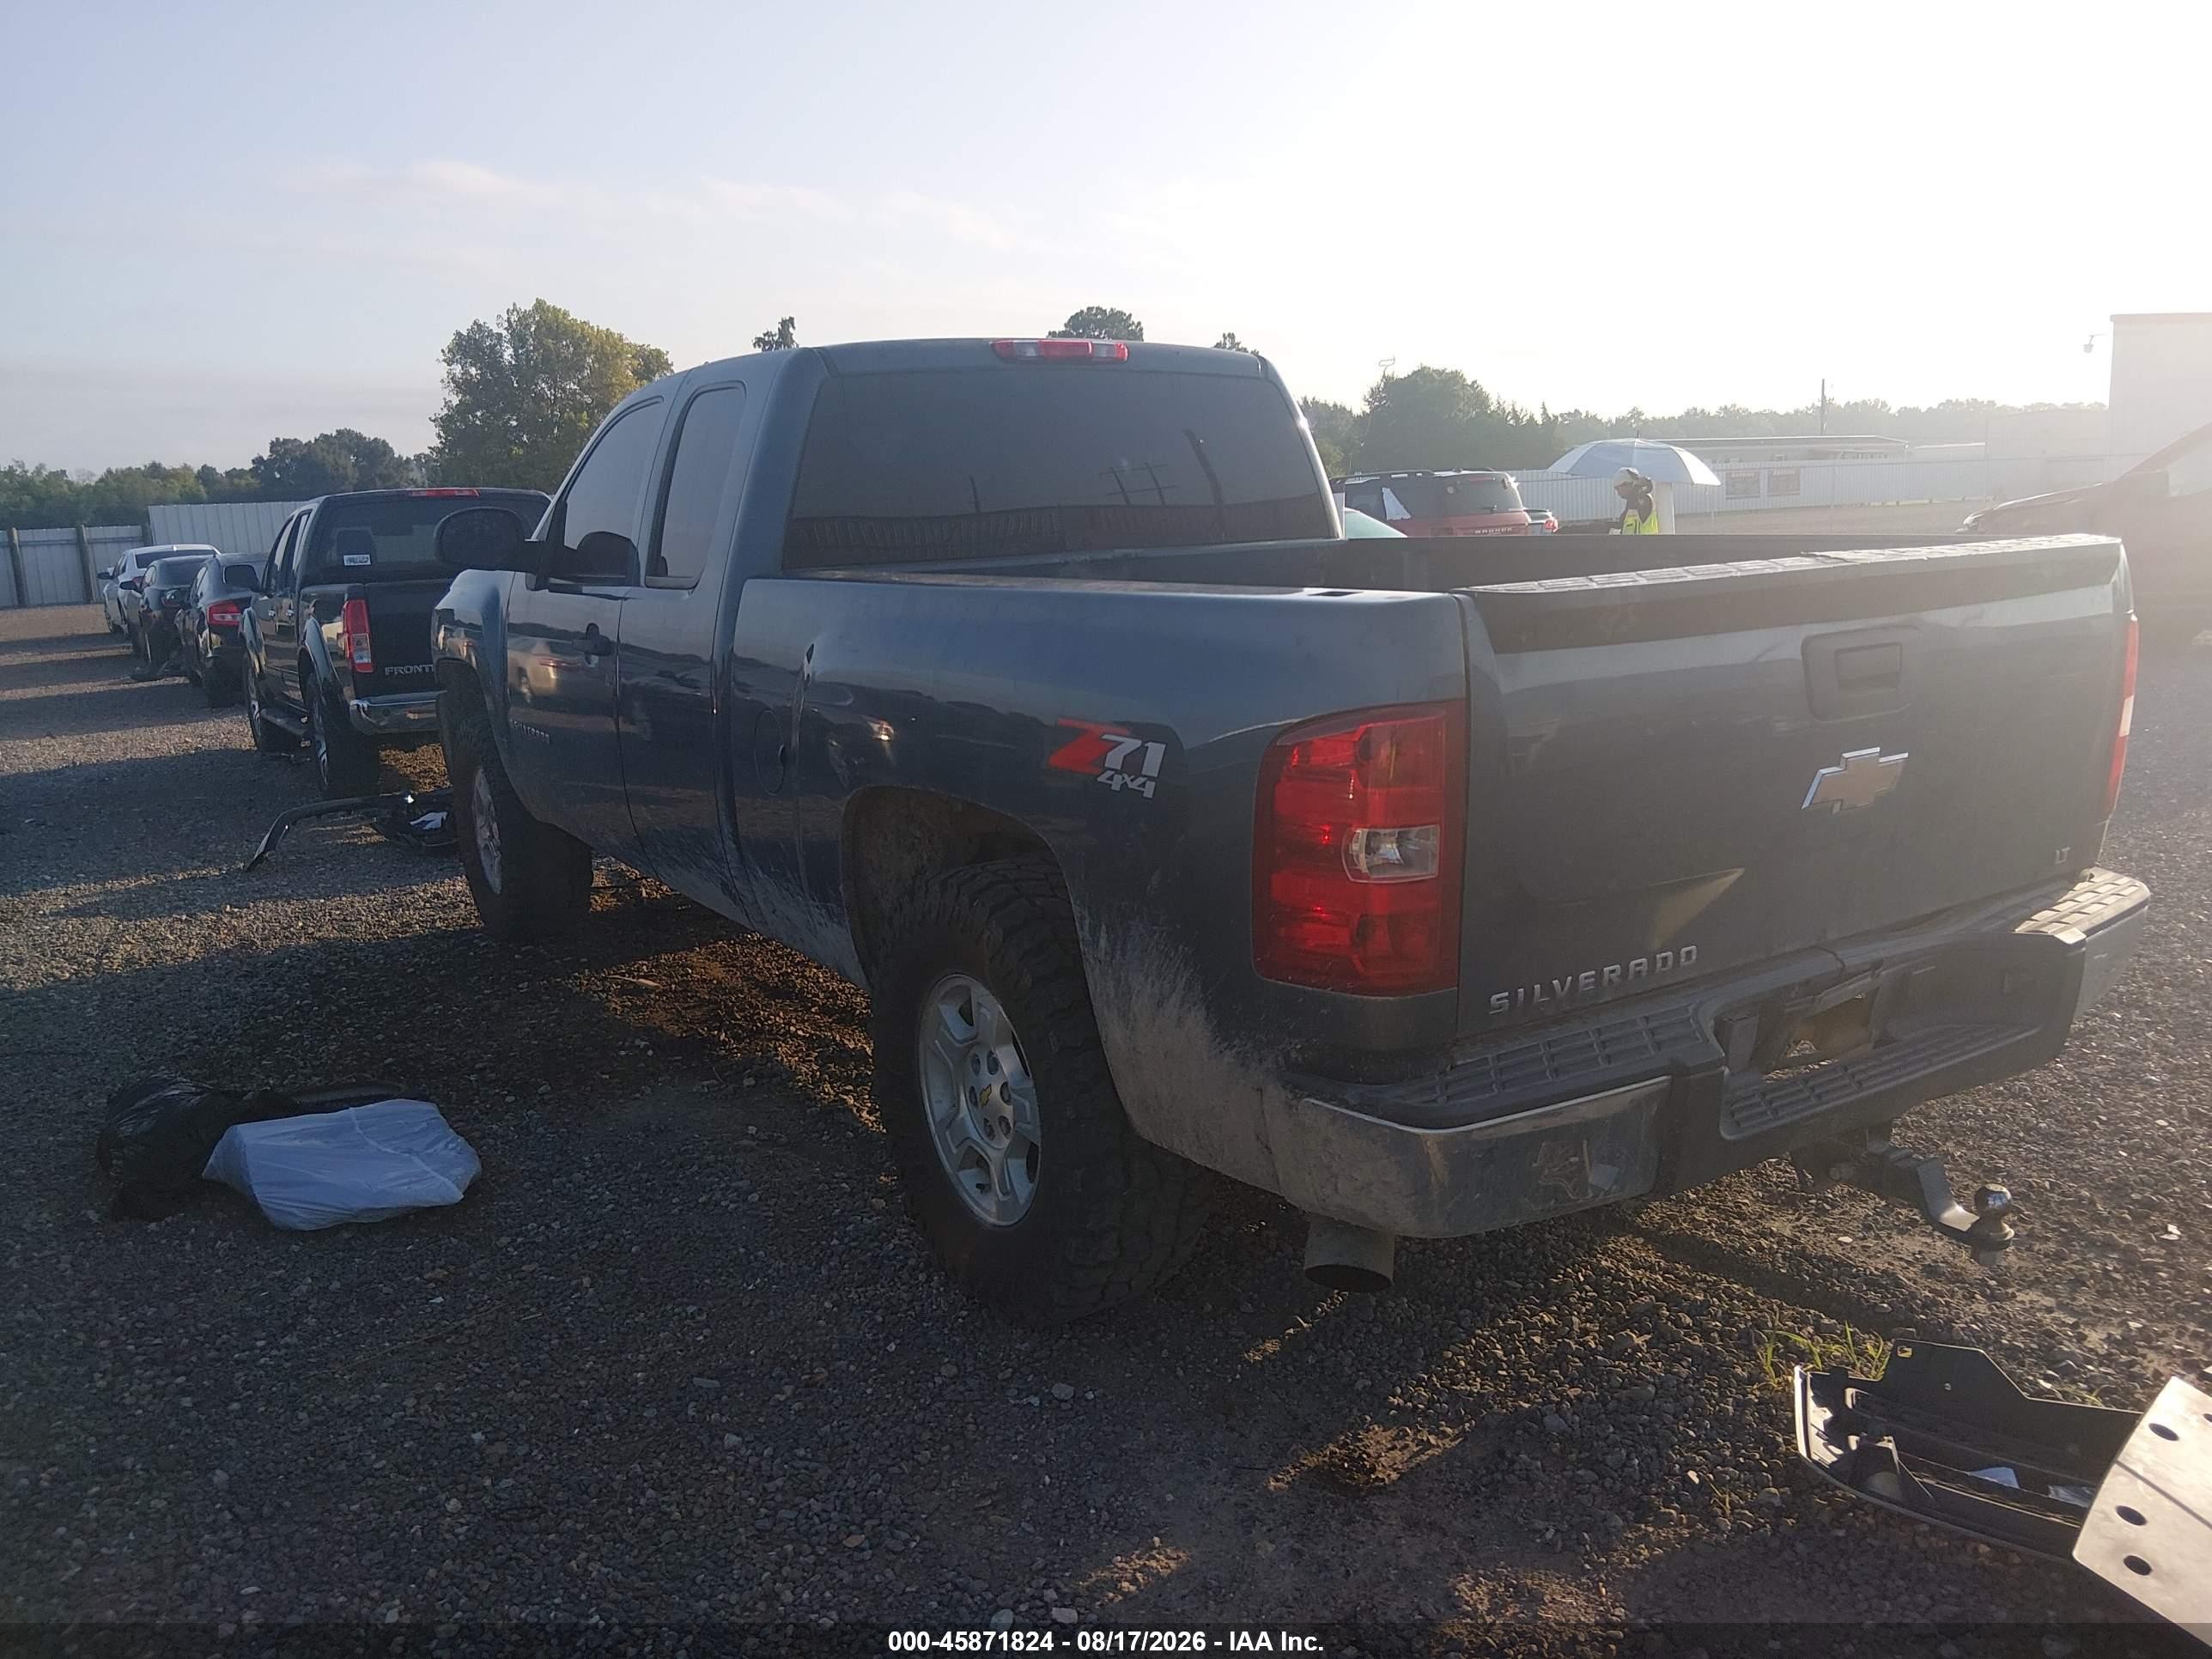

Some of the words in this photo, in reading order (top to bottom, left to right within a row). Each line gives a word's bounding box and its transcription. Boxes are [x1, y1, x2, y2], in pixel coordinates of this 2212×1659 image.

[1048, 717, 1167, 777] Z71
[2055, 847, 2070, 865] LT
[1488, 945, 1698, 1014] SILVERADO
